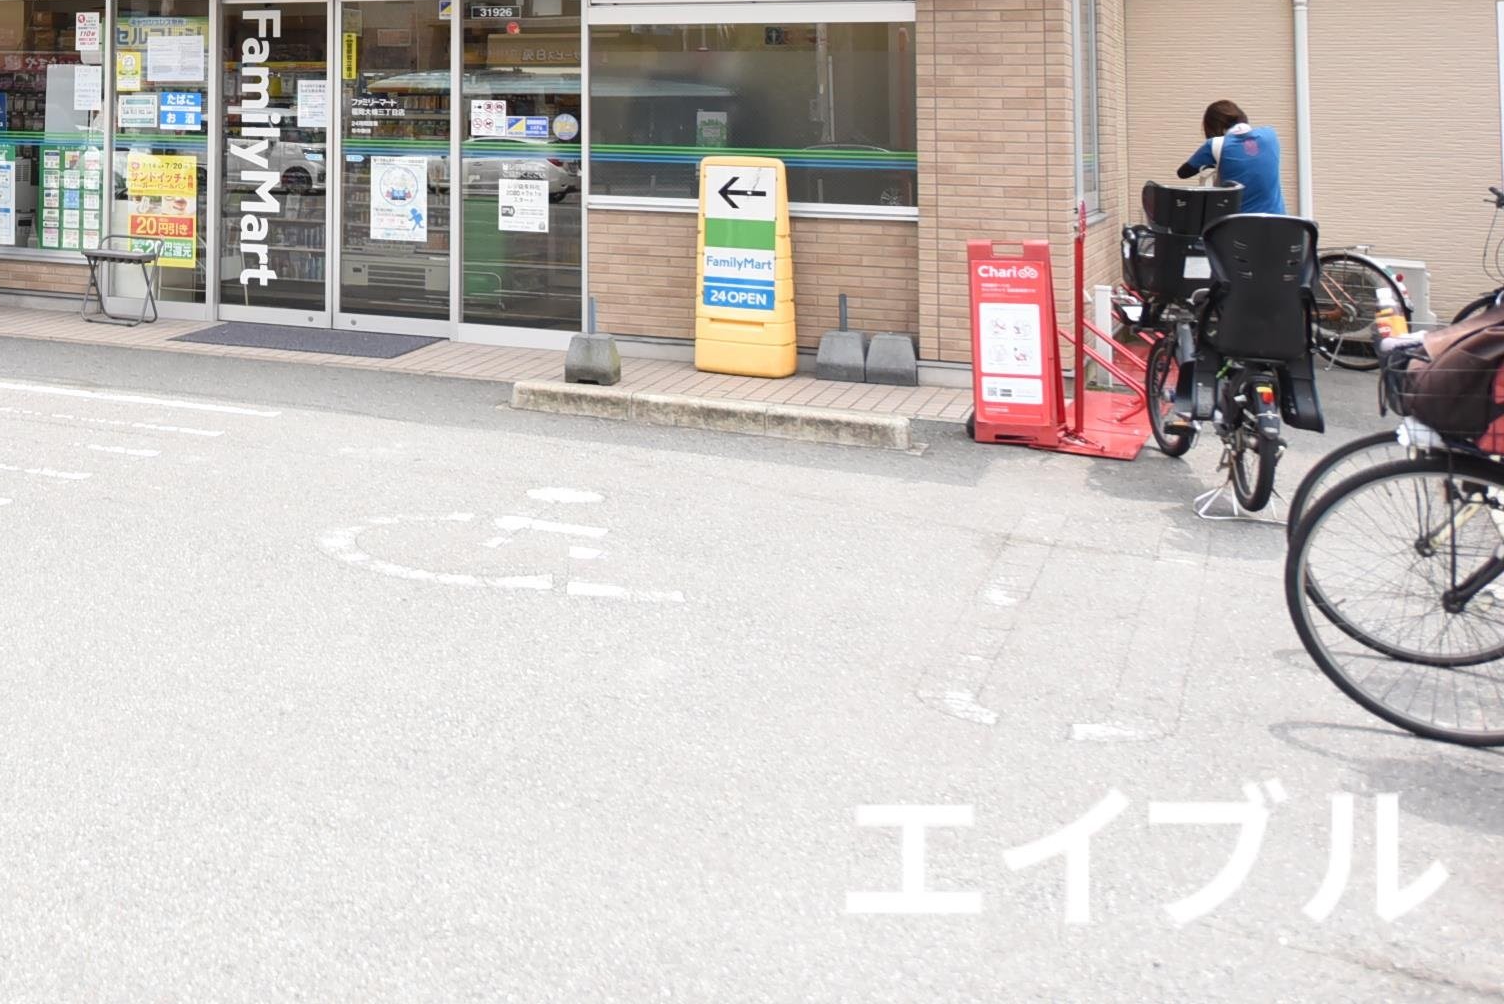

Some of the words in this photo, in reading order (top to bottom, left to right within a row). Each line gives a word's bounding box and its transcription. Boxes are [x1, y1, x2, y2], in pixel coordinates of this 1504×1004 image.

[479, 8, 513, 17] 31926
[166, 93, 195, 105] たばこ
[351, 98, 398, 107] ファミリーマート
[230, 9, 281, 286] FamilyMart
[706, 255, 773, 272] FamilyMart
